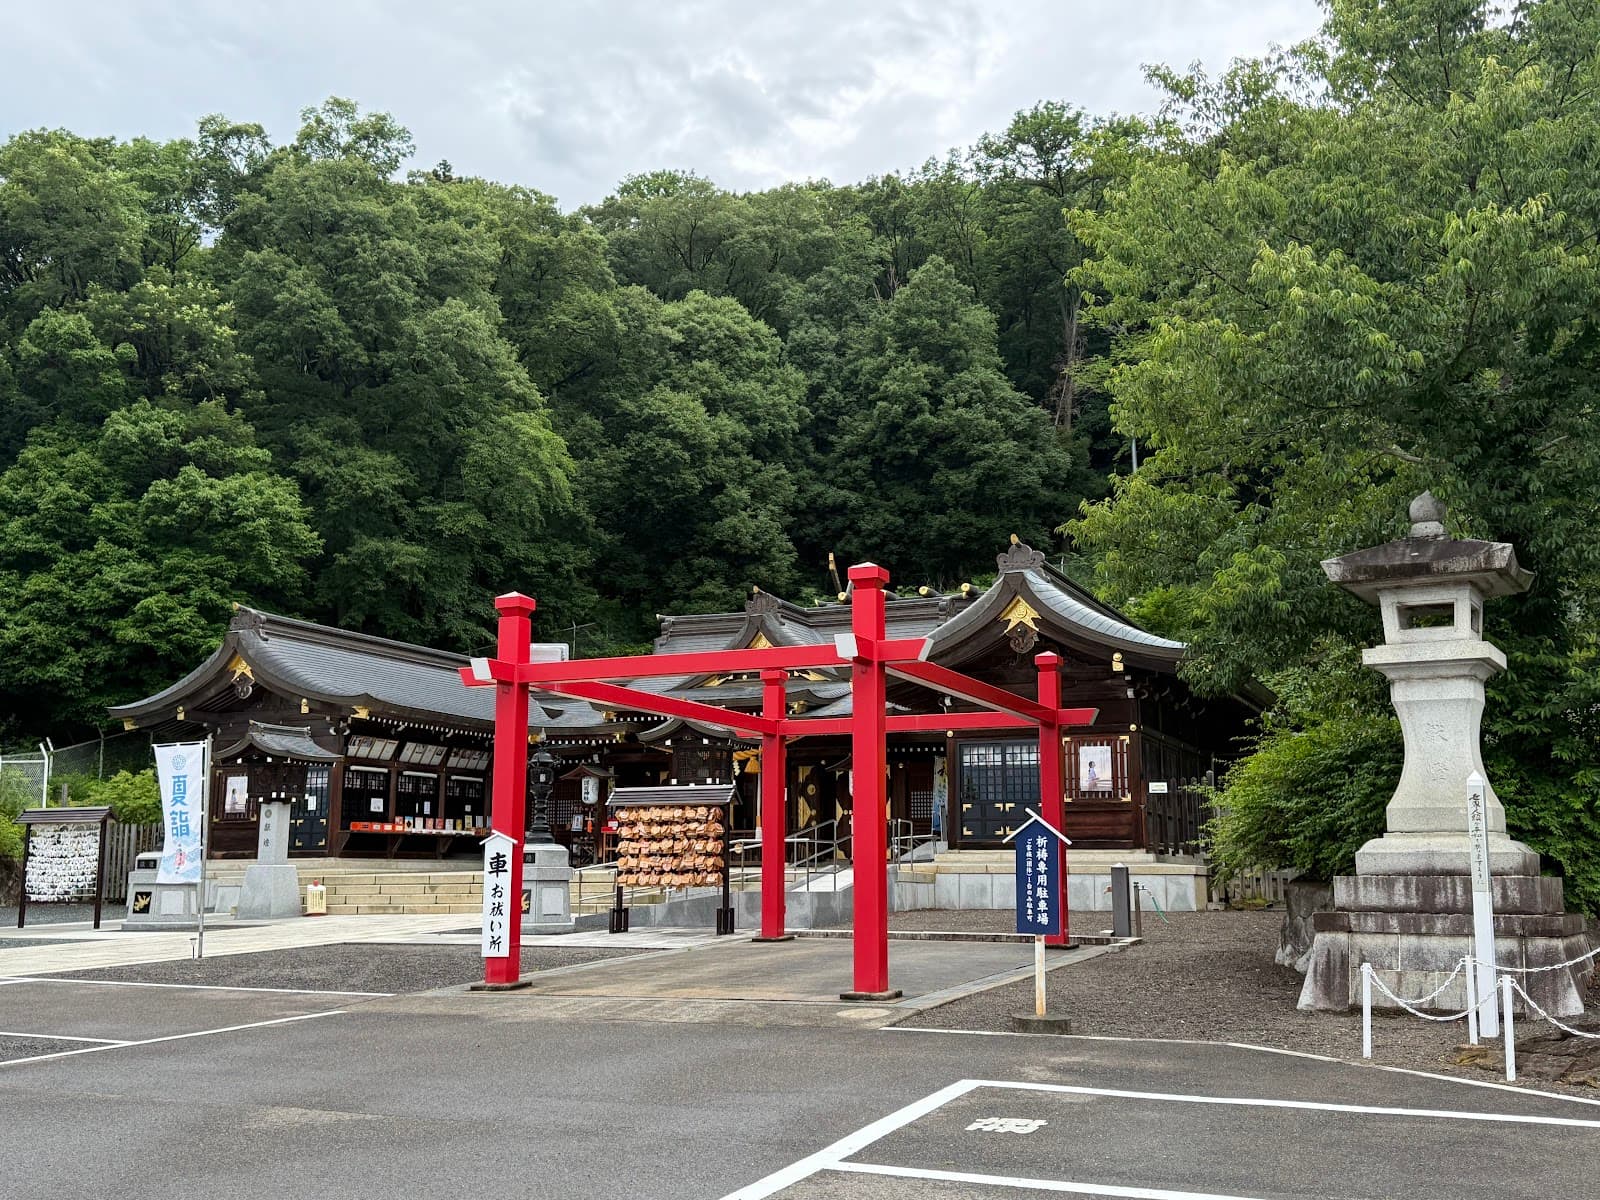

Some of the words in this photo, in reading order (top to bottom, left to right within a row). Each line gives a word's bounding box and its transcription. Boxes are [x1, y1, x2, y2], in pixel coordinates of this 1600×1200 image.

[170, 774, 190, 837] 夏詣
[1035, 835, 1049, 926] 祈祷専用駐車場
